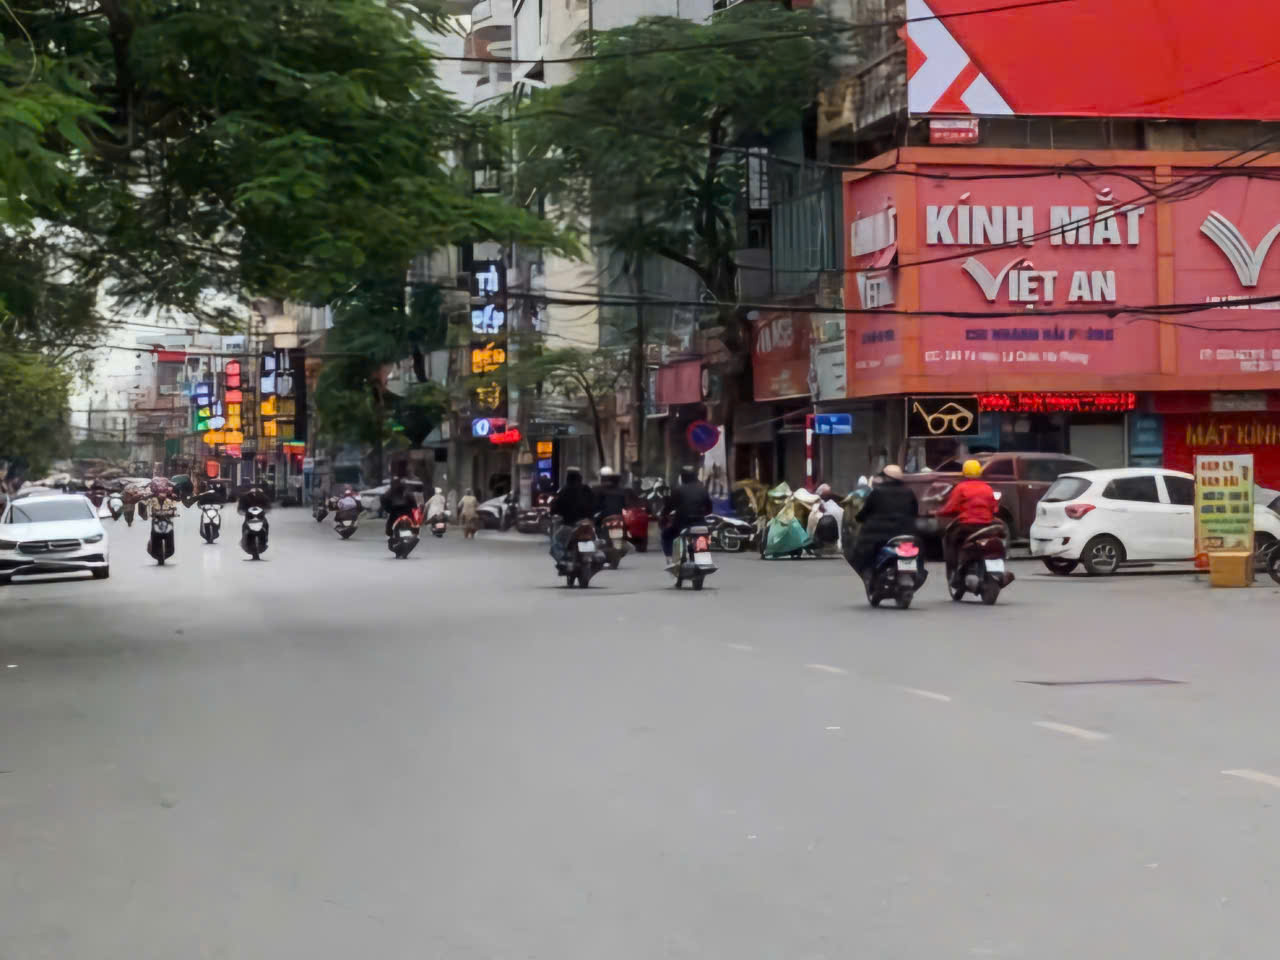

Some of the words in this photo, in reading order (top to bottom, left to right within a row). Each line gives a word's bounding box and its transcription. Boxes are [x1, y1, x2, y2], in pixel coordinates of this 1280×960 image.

[926, 191, 1035, 246] KÍNH
[1050, 187, 1146, 246] MẮT
[1068, 270, 1117, 303] AN
